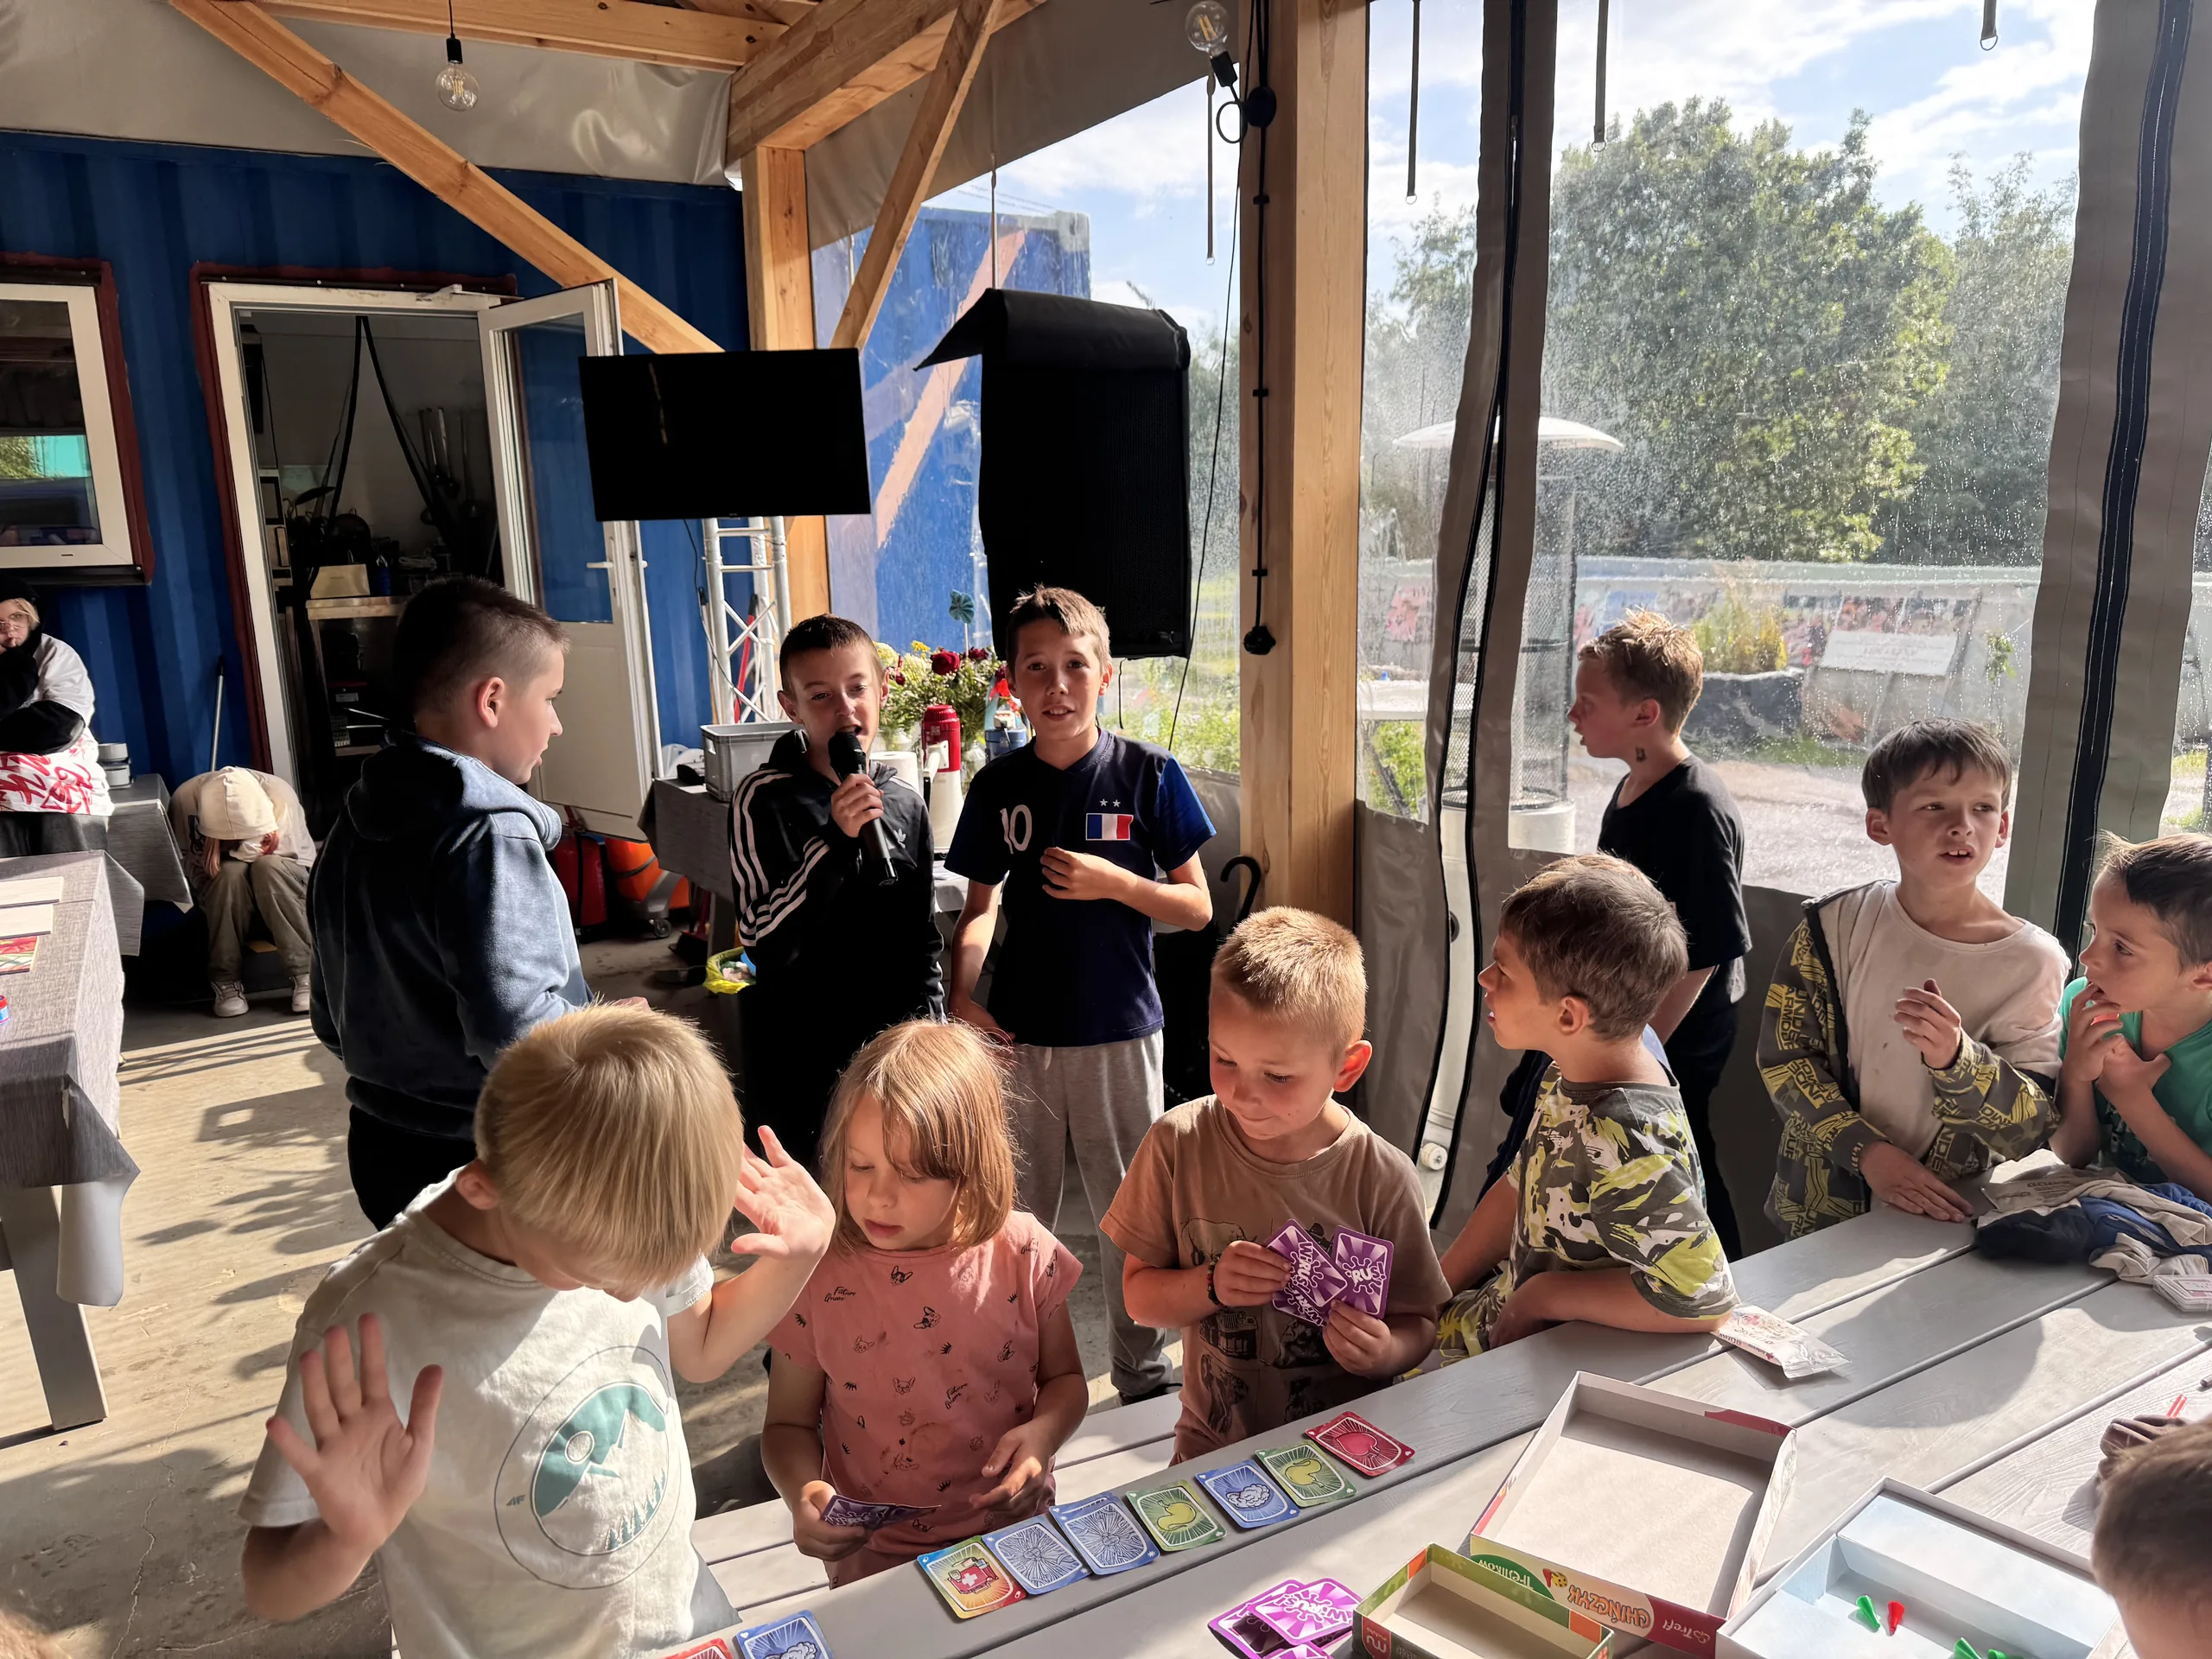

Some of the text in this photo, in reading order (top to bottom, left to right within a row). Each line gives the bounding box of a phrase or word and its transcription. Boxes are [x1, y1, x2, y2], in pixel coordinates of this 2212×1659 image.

[1000, 804, 1033, 855] 10
[1789, 988, 1809, 1044] UNDE
[1787, 1061, 1827, 1107] UNDE
[1798, 1058, 1836, 1103] ARMO
[1345, 1262, 1387, 1285] RUS!
[1567, 1585, 1650, 1630] CHIŃCZYK
[1662, 1618, 1695, 1639] Trefl
